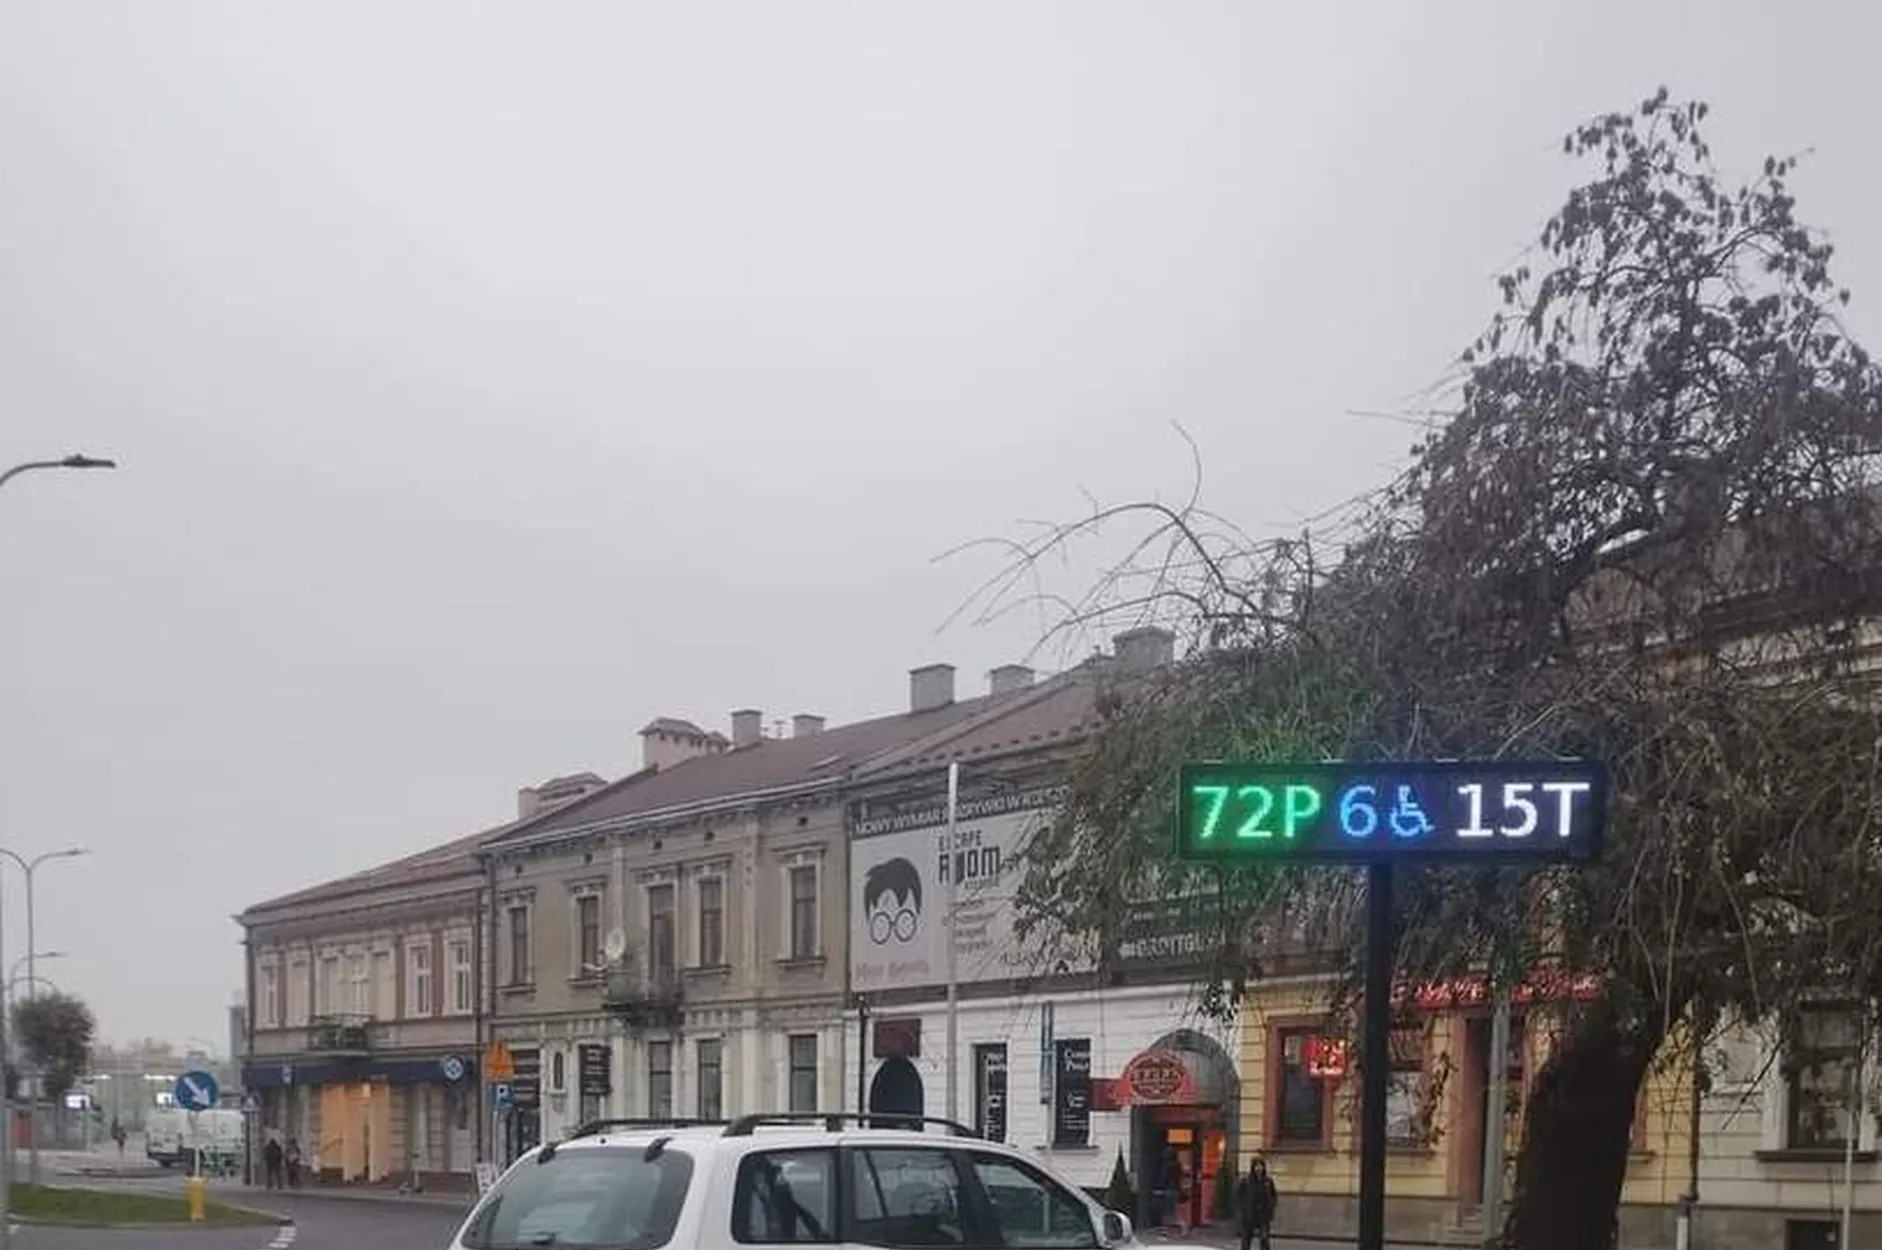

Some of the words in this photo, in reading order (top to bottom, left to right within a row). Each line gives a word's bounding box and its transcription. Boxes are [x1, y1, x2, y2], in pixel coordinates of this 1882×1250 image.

[1193, 785, 1321, 838] 72P
[1339, 785, 1377, 837] 6
[1457, 782, 1590, 837] 15T
